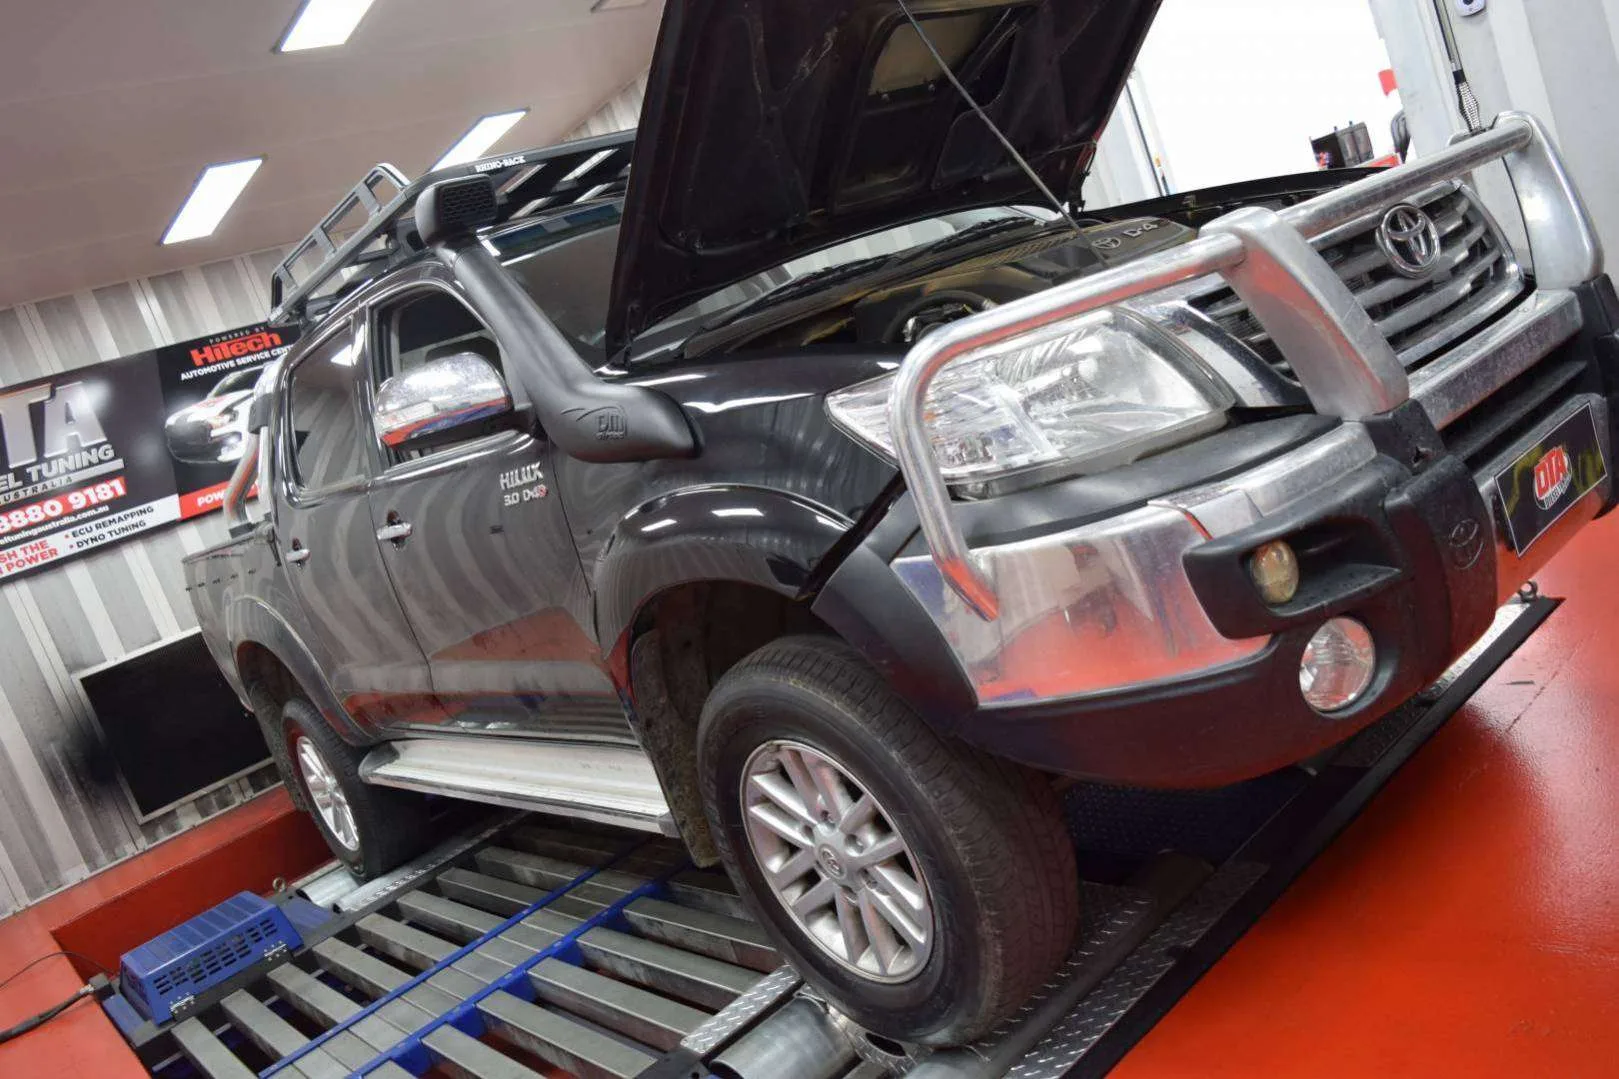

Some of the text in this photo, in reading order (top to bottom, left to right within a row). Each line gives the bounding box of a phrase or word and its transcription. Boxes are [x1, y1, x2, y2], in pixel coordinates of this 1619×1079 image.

[190, 332, 283, 367] HiTech
[180, 361, 236, 381] AUTOMOTIVE
[235, 350, 271, 366] SERVICE
[26, 444, 115, 482] TUNING
[499, 461, 544, 491] HILUX
[68, 479, 126, 510] 9181
[72, 506, 155, 539] ECU REMAPPING
[76, 520, 147, 549] DYNO TUNING
[5, 548, 59, 572] POWER
[20, 540, 49, 556] THE
